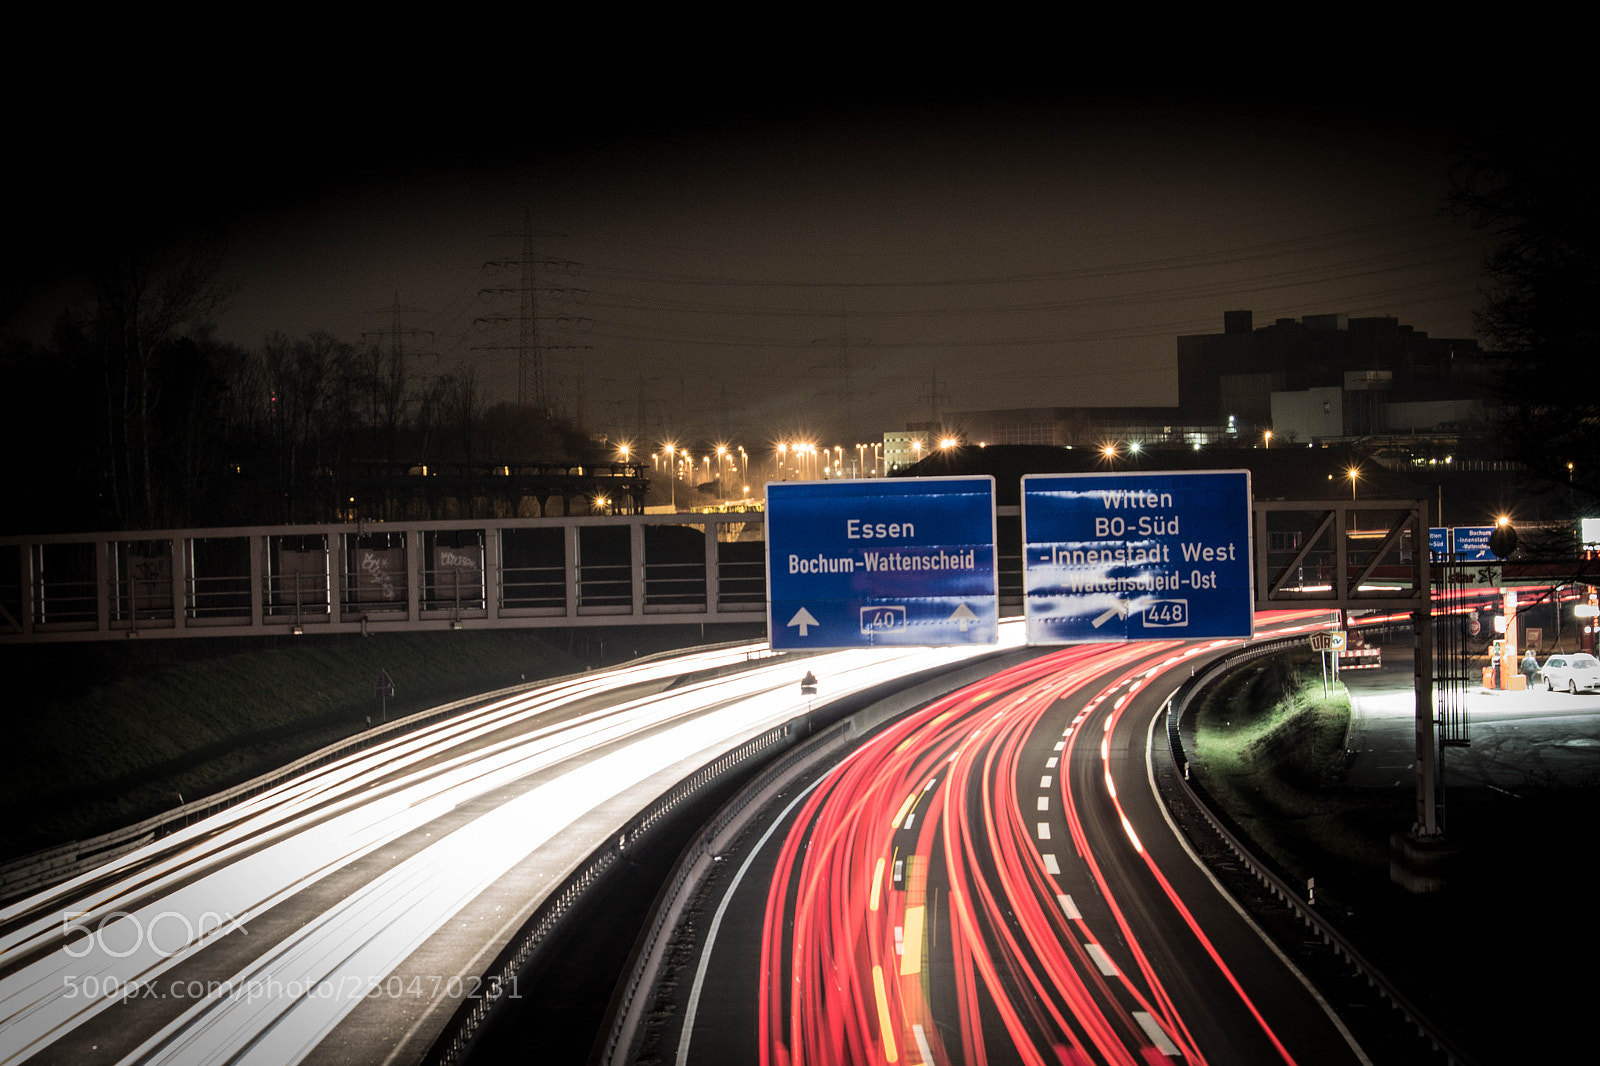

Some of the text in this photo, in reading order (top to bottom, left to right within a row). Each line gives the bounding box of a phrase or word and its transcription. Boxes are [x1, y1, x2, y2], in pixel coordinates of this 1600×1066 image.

[1101, 489, 1173, 509] Witten
[847, 519, 915, 539] Essen
[1095, 516, 1179, 537] BO-Süd
[788, 550, 975, 574] Bochum-Wattenscheid
[1040, 542, 1236, 565] -Innenstadt West
[1061, 570, 1217, 593] -Wattenscheid-Ost
[873, 611, 894, 628] 40
[1148, 605, 1183, 622] 448
